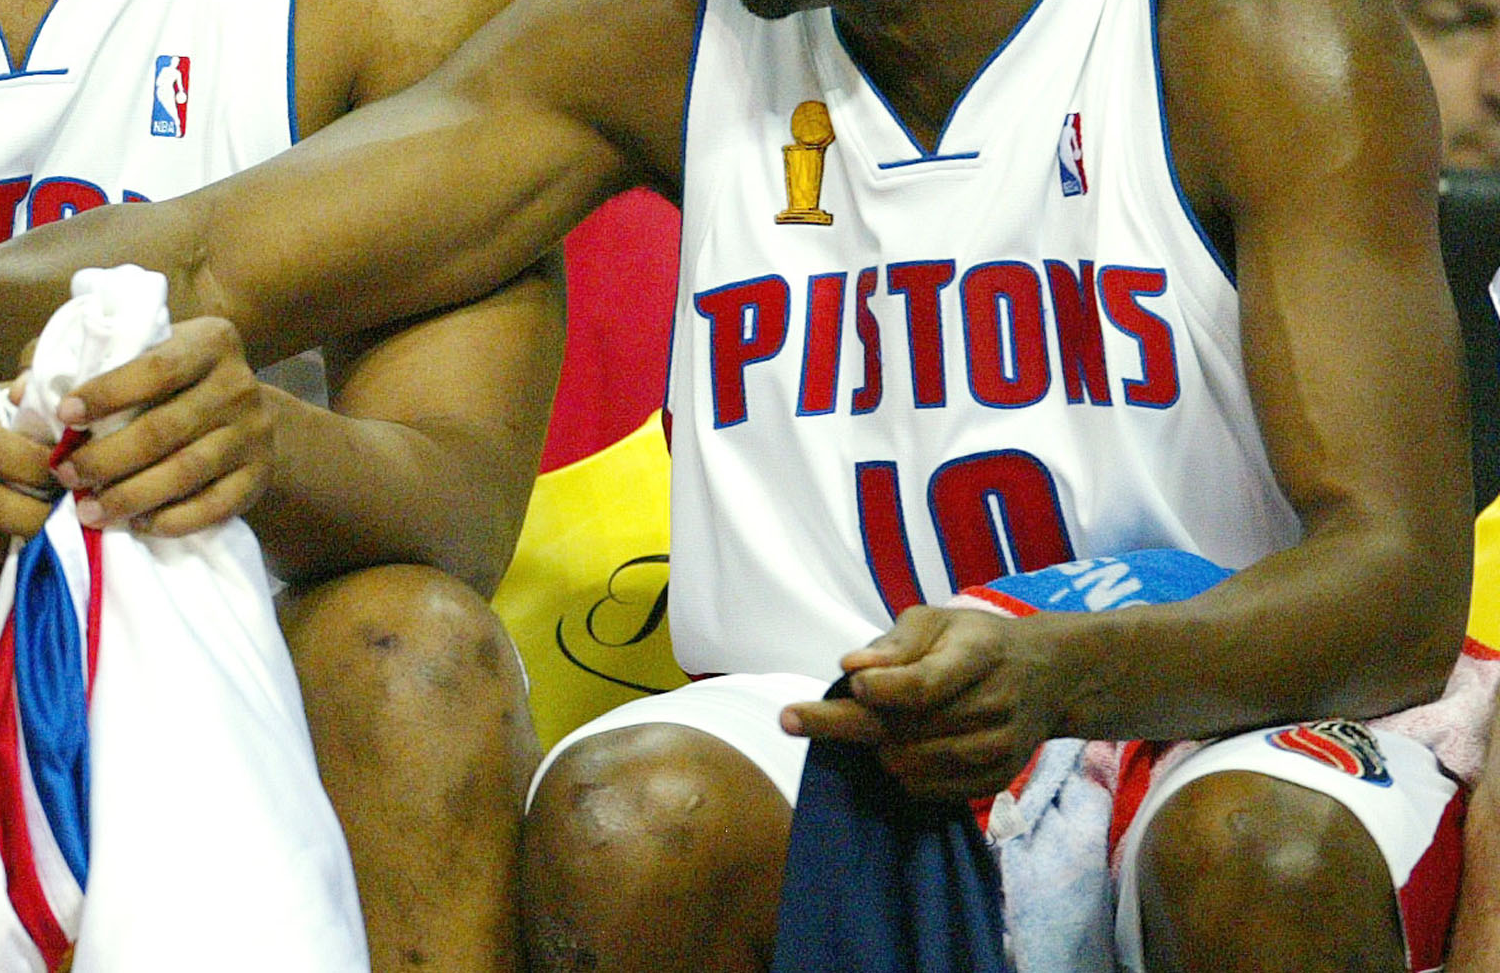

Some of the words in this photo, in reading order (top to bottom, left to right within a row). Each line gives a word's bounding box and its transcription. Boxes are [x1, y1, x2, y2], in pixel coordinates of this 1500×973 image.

[153, 120, 175, 133] NBA
[693, 258, 1181, 431] PISTONS
[854, 447, 1077, 625] 10
